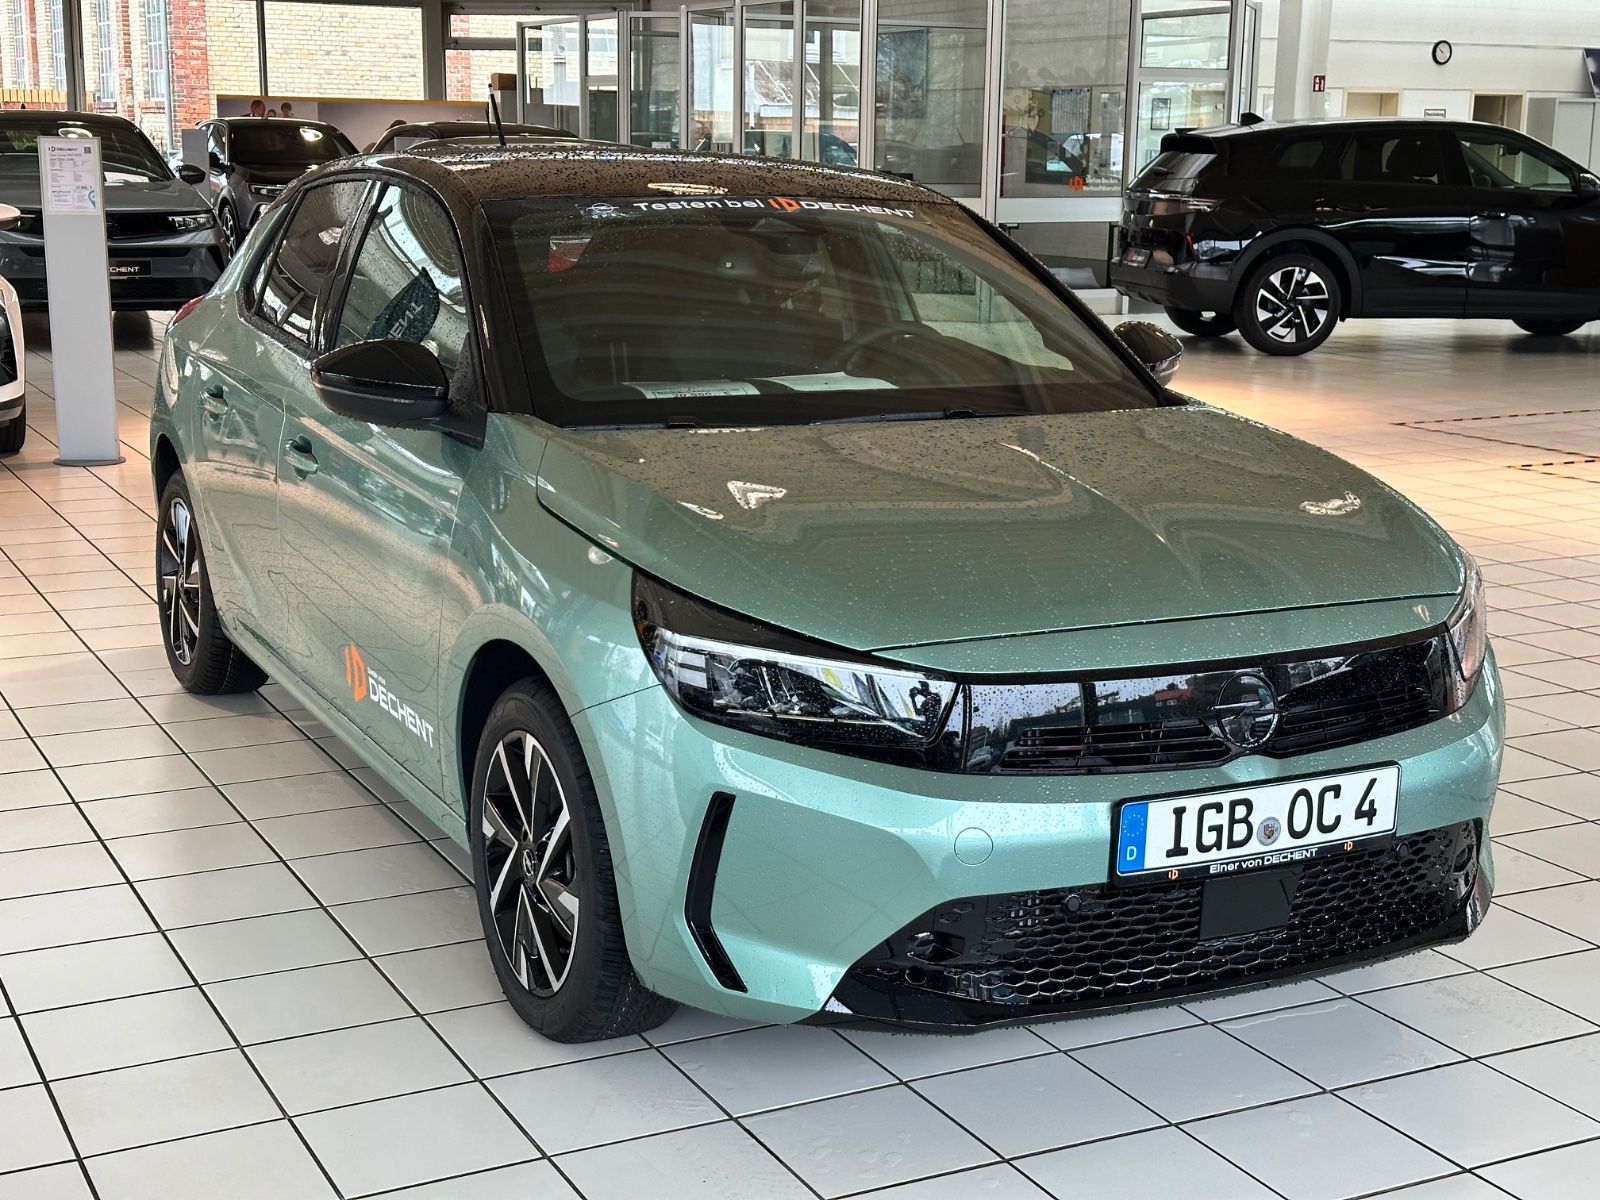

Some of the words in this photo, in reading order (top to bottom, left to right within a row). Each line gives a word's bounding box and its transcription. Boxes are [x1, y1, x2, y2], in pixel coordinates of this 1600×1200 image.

[633, 200, 721, 211] Testen
[799, 201, 914, 218] DECHENT
[368, 676, 434, 748] DECHENT
[1165, 797, 1254, 859] IGB
[1287, 783, 1342, 840] OC
[1354, 777, 1378, 827] 4
[1126, 845, 1137, 862] D
[1209, 861, 1240, 874] Einer
[1241, 858, 1262, 869] von
[1263, 848, 1318, 865] DECHENT
